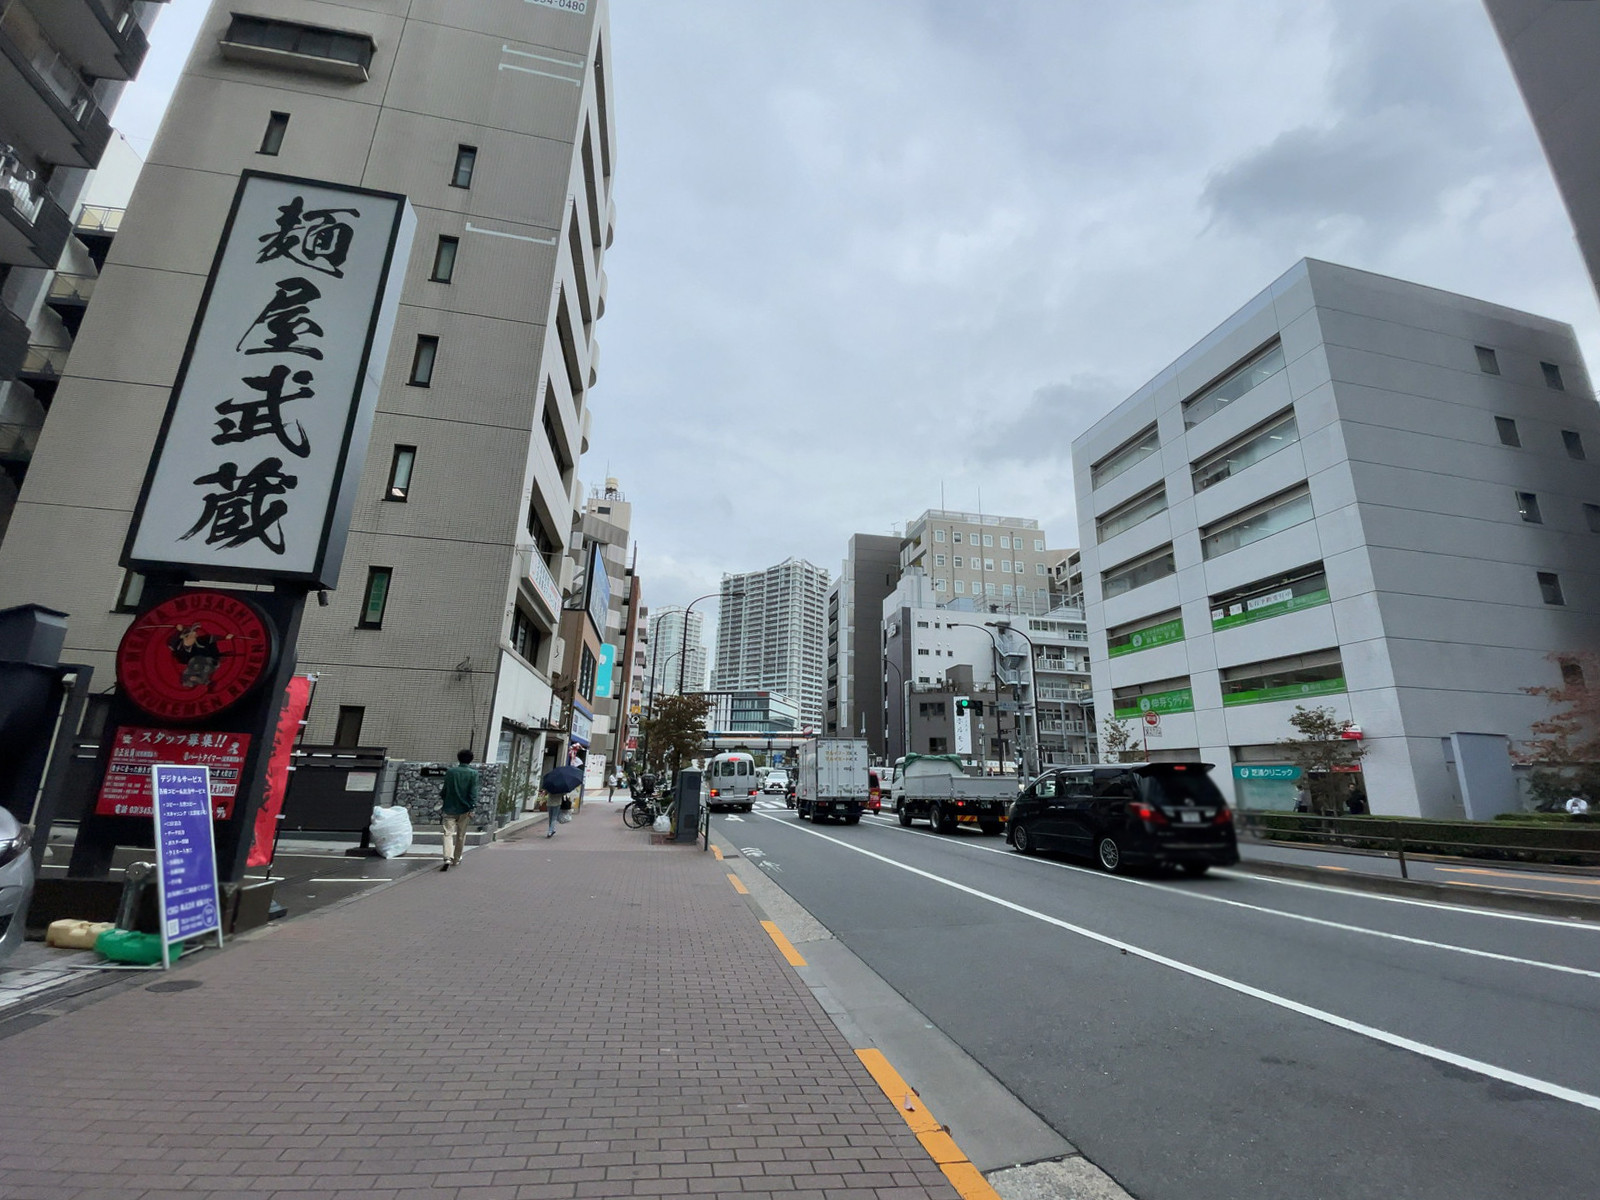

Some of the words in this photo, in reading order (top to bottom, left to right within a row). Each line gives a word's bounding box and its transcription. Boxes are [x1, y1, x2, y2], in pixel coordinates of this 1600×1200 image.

[175, 196, 360, 555] 麺屋武蔵
[125, 609, 169, 659] MENYA
[174, 595, 254, 625] MUSASHI
[134, 681, 223, 716] TSUKEMEN
[227, 643, 265, 698] RAMEN
[160, 774, 203, 784] デジタルサービス
